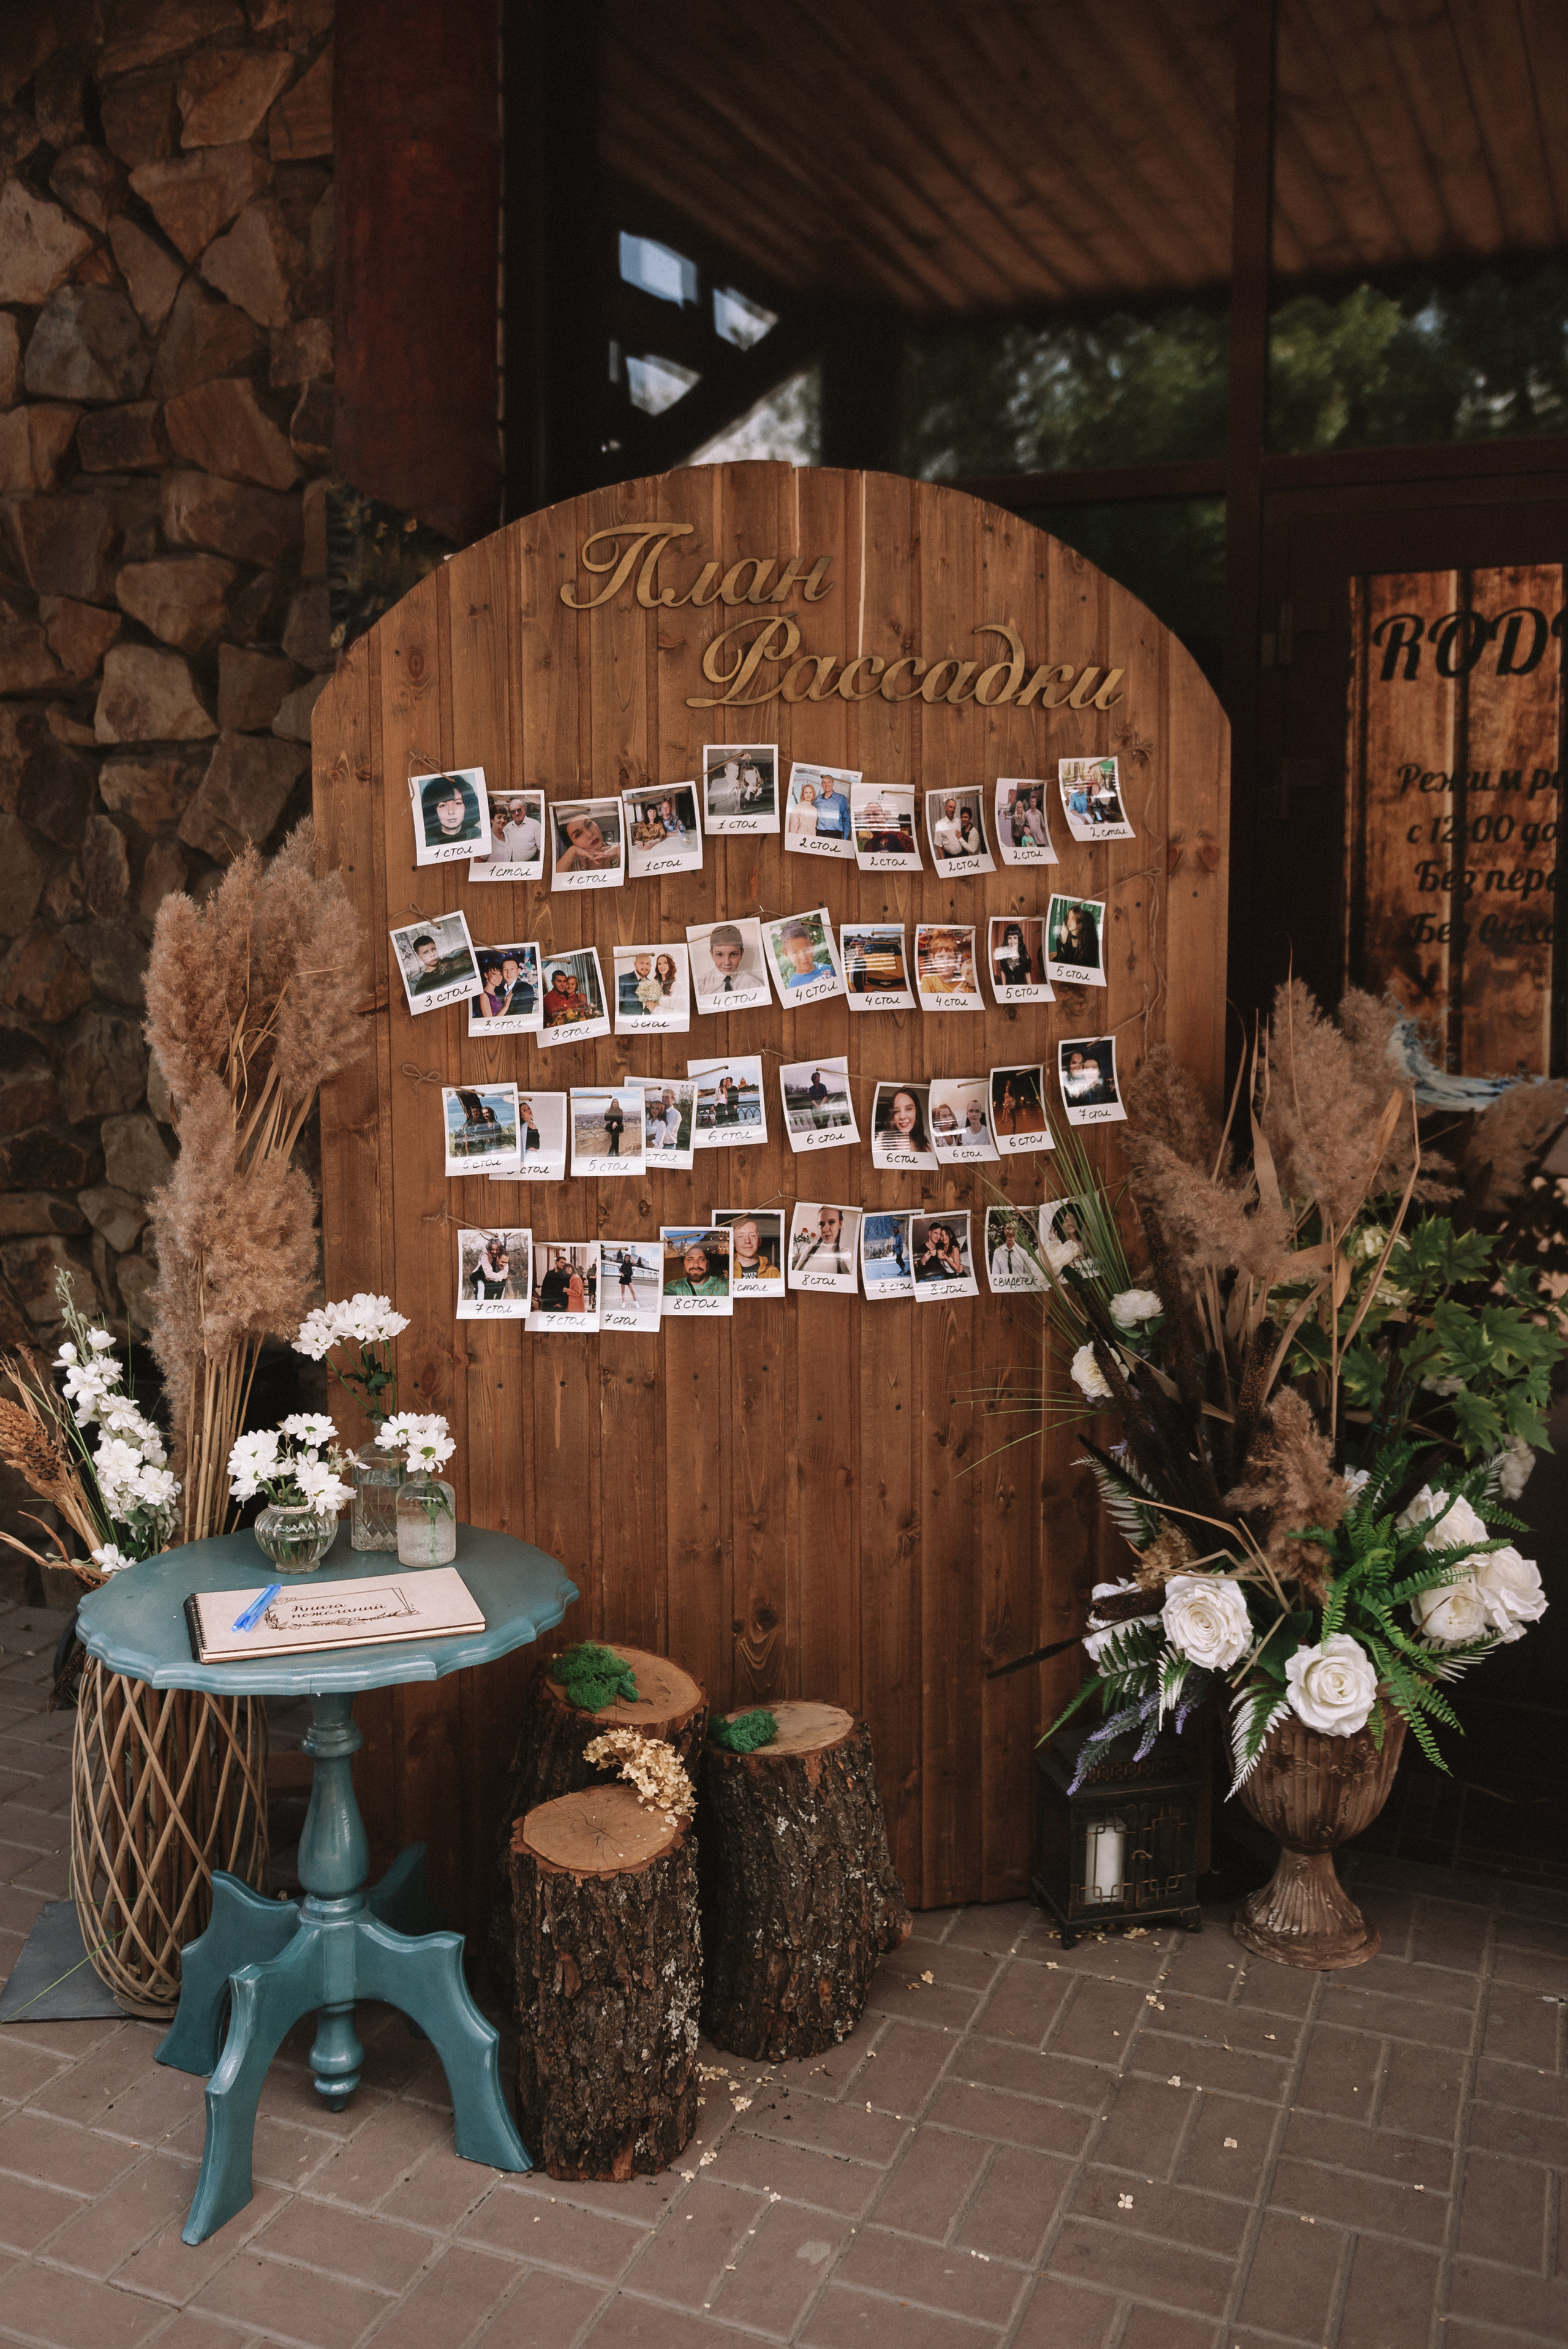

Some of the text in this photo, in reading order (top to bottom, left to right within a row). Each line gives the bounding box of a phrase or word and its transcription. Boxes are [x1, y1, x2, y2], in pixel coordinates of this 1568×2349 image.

[560, 523, 834, 608] План
[686, 613, 1126, 711] Рассадки
[717, 819, 726, 830] 1
[1430, 815, 1515, 844] 1200
[1090, 826, 1101, 838] 2
[799, 837, 808, 849] 2
[434, 848, 441, 859] 1
[1013, 850, 1021, 860] 2
[644, 861, 652, 872] 1
[870, 856, 879, 866] 2
[948, 861, 956, 872] 2
[489, 865, 497, 877] 1
[567, 875, 575, 885] 1
[1057, 965, 1065, 977] 5
[796, 988, 803, 1002] 4
[1005, 987, 1014, 999] 5
[424, 994, 433, 1007] 3
[712, 996, 722, 1007] 4
[865, 994, 873, 1006] 4
[935, 995, 942, 1007] 4
[483, 1019, 491, 1032] 3
[630, 1018, 639, 1029] 3
[551, 1029, 560, 1040] 3
[1079, 1108, 1087, 1121] 7
[708, 1130, 717, 1142] 6
[806, 1133, 815, 1145] 6
[1009, 1137, 1017, 1148] 6
[886, 1152, 894, 1163] 6
[952, 1149, 959, 1158] 6
[462, 1159, 470, 1170] 5
[588, 1159, 598, 1171] 5
[801, 1274, 811, 1286] 8
[993, 1276, 1038, 1288] свидетел
[878, 1282, 887, 1293] 8
[930, 1283, 939, 1295] 8
[475, 1303, 484, 1314] 7
[673, 1298, 683, 1310] 8
[546, 1314, 556, 1326] 7
[604, 1313, 614, 1324] 7
[291, 1603, 347, 1612] Книга
[292, 1603, 387, 1619] пожеланий
